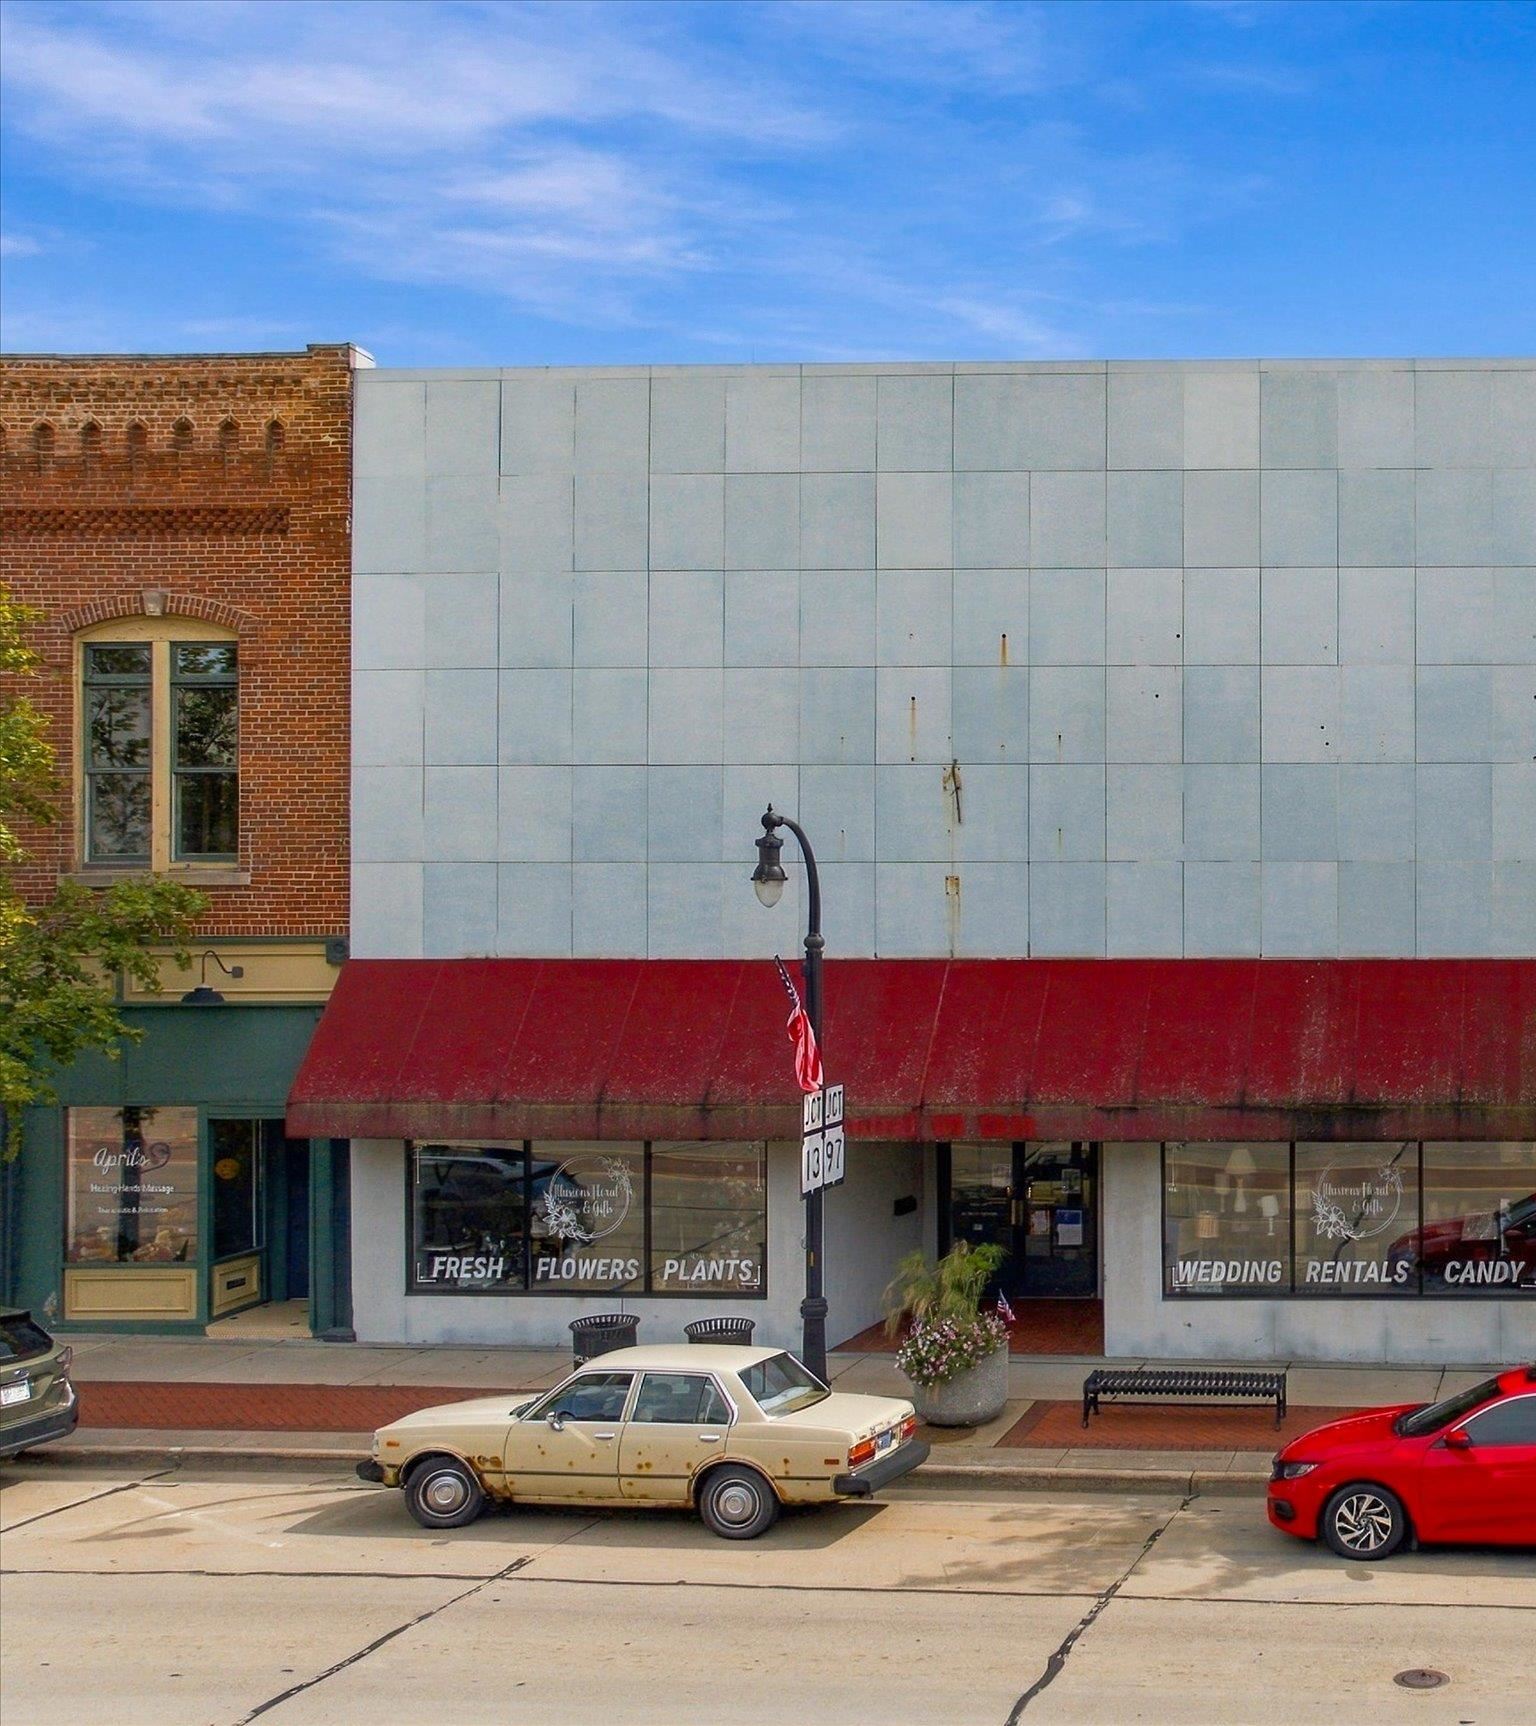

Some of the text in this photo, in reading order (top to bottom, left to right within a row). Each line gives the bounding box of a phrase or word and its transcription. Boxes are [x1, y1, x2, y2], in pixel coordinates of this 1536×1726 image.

[805, 1096, 822, 1126] JCT
[827, 1091, 842, 1119] JCT
[807, 1147, 820, 1182] 13
[826, 1139, 842, 1174] 97
[432, 1257, 754, 1281] FRESH FLOWERS PLANTS
[1178, 1260, 1525, 1283] WEDDING RENTALS CANDY
